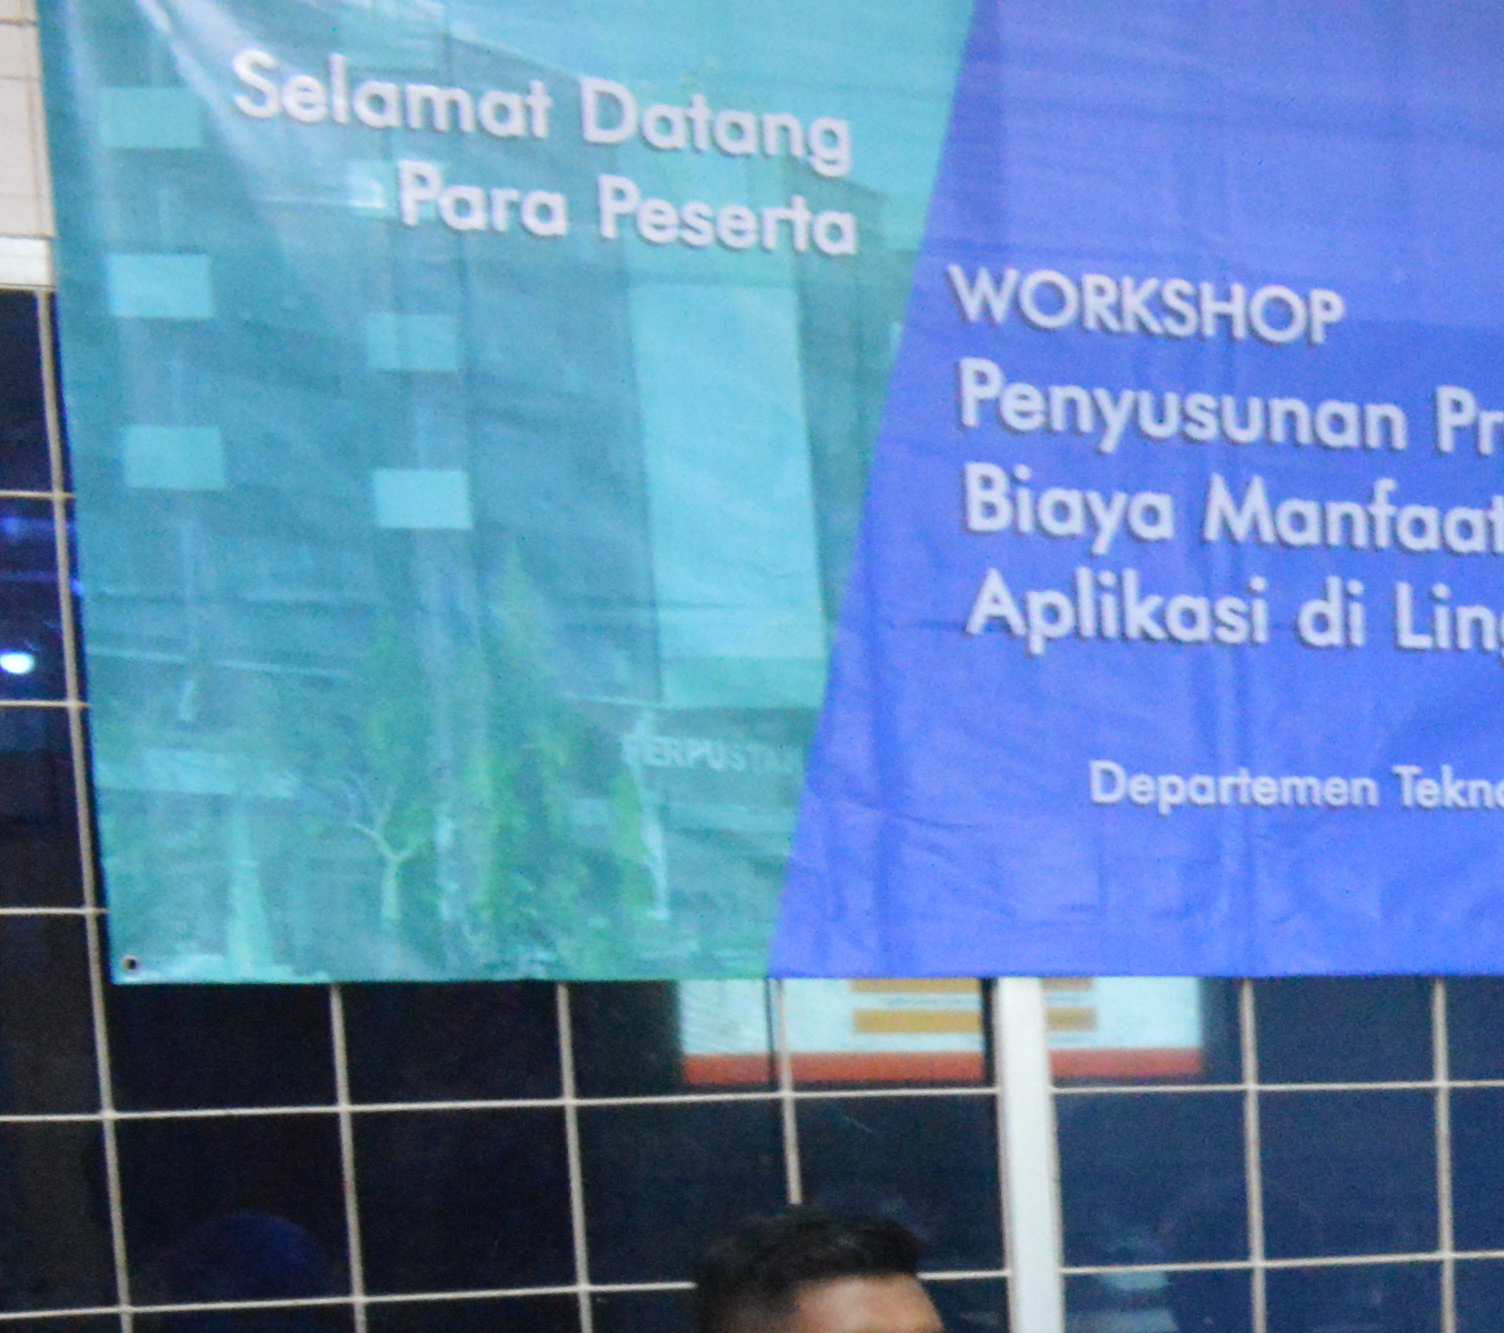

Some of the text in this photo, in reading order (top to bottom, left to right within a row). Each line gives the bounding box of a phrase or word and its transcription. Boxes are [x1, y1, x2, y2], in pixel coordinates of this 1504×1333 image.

[232, 48, 852, 177] Selamat Datang
[399, 159, 857, 255] Para Peserta
[947, 264, 1346, 343] WORKSHOP
[959, 357, 1408, 453] Penyusunan
[965, 462, 1176, 554] Biaya
[966, 567, 1270, 655] Aplikasi
[1298, 576, 1366, 647] di
[1089, 759, 1380, 815] Departemen
